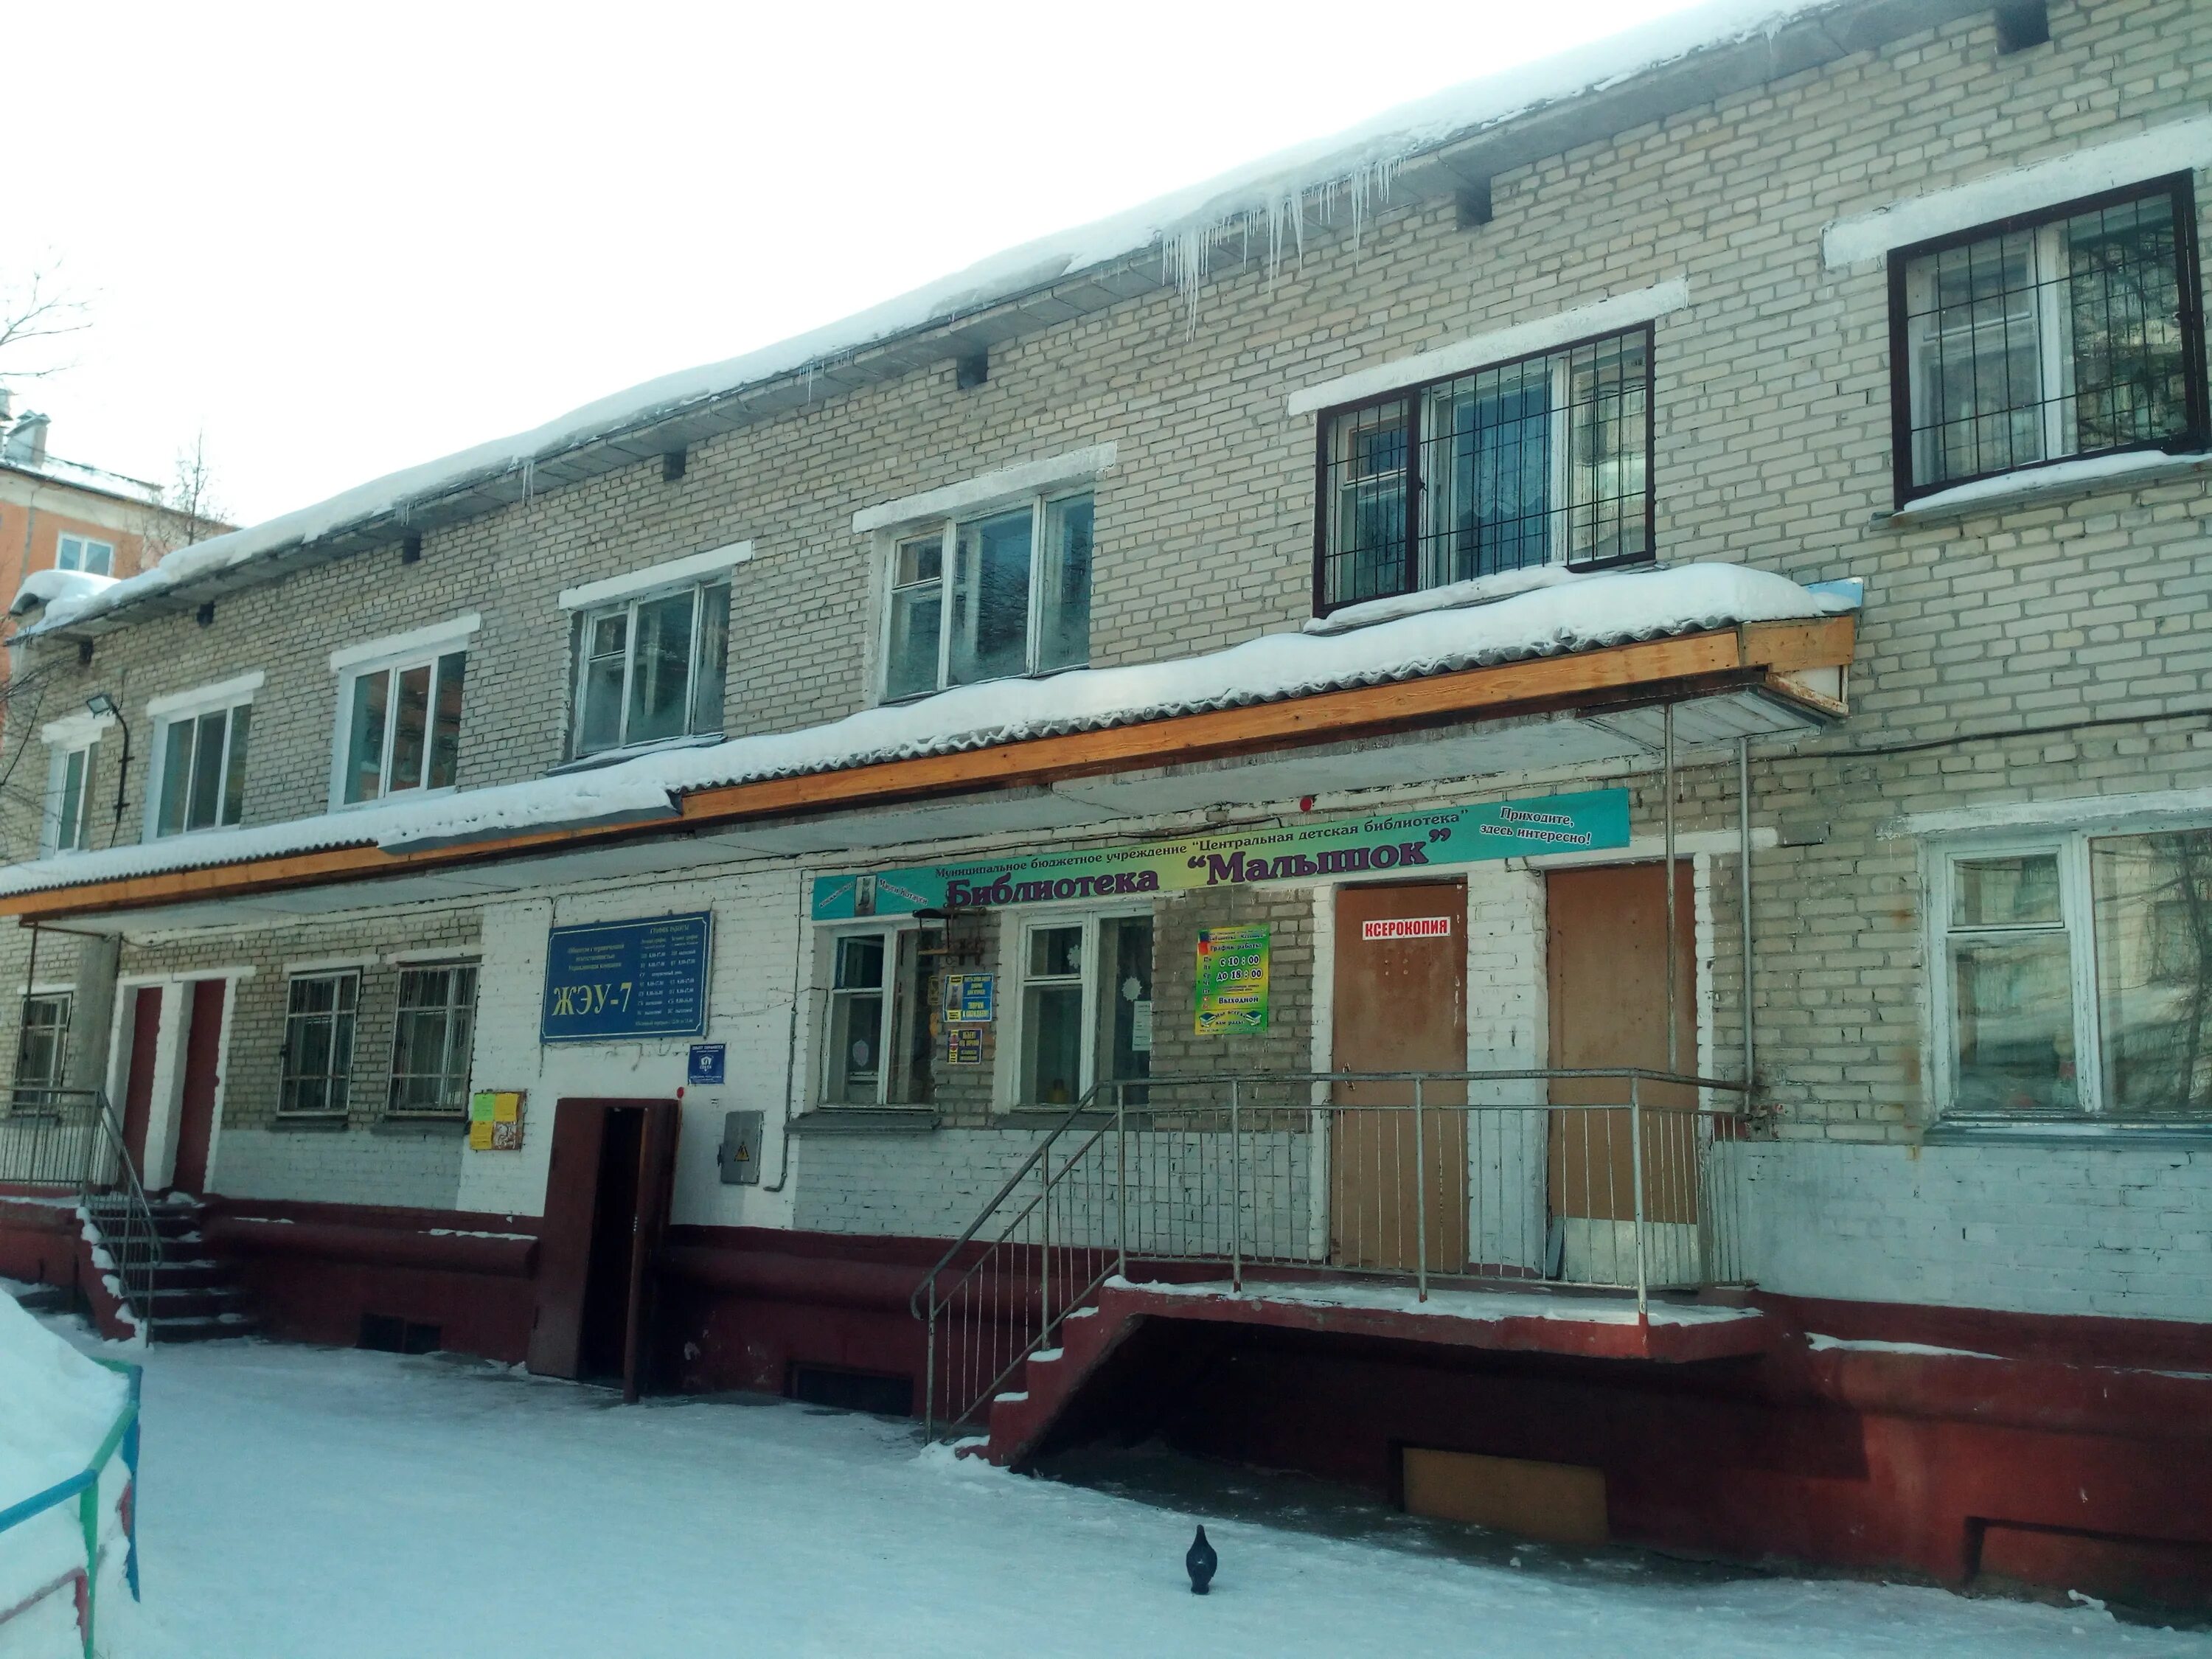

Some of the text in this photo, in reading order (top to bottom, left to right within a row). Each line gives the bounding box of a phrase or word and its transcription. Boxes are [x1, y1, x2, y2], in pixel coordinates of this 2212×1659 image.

[1500, 806, 1575, 827] Приходите,
[1480, 824, 1591, 846] здесь интересно!
[936, 862, 1027, 879] Муниципальное
[1031, 855, 1102, 869] бюджетное
[1107, 845, 1187, 863] учреждение
[1298, 825, 1358, 841] детская
[946, 870, 1160, 908] Библиотека
[1365, 919, 1447, 937] КСЕРОКОПИЯ
[1228, 956, 1239, 966] 10
[1248, 955, 1260, 964] 00
[1216, 972, 1228, 981] до
[1231, 969, 1242, 979] 18
[1251, 969, 1262, 978] 00
[552, 981, 633, 1016] ЖЭУ-7
[1219, 996, 1259, 1004] Выходной
